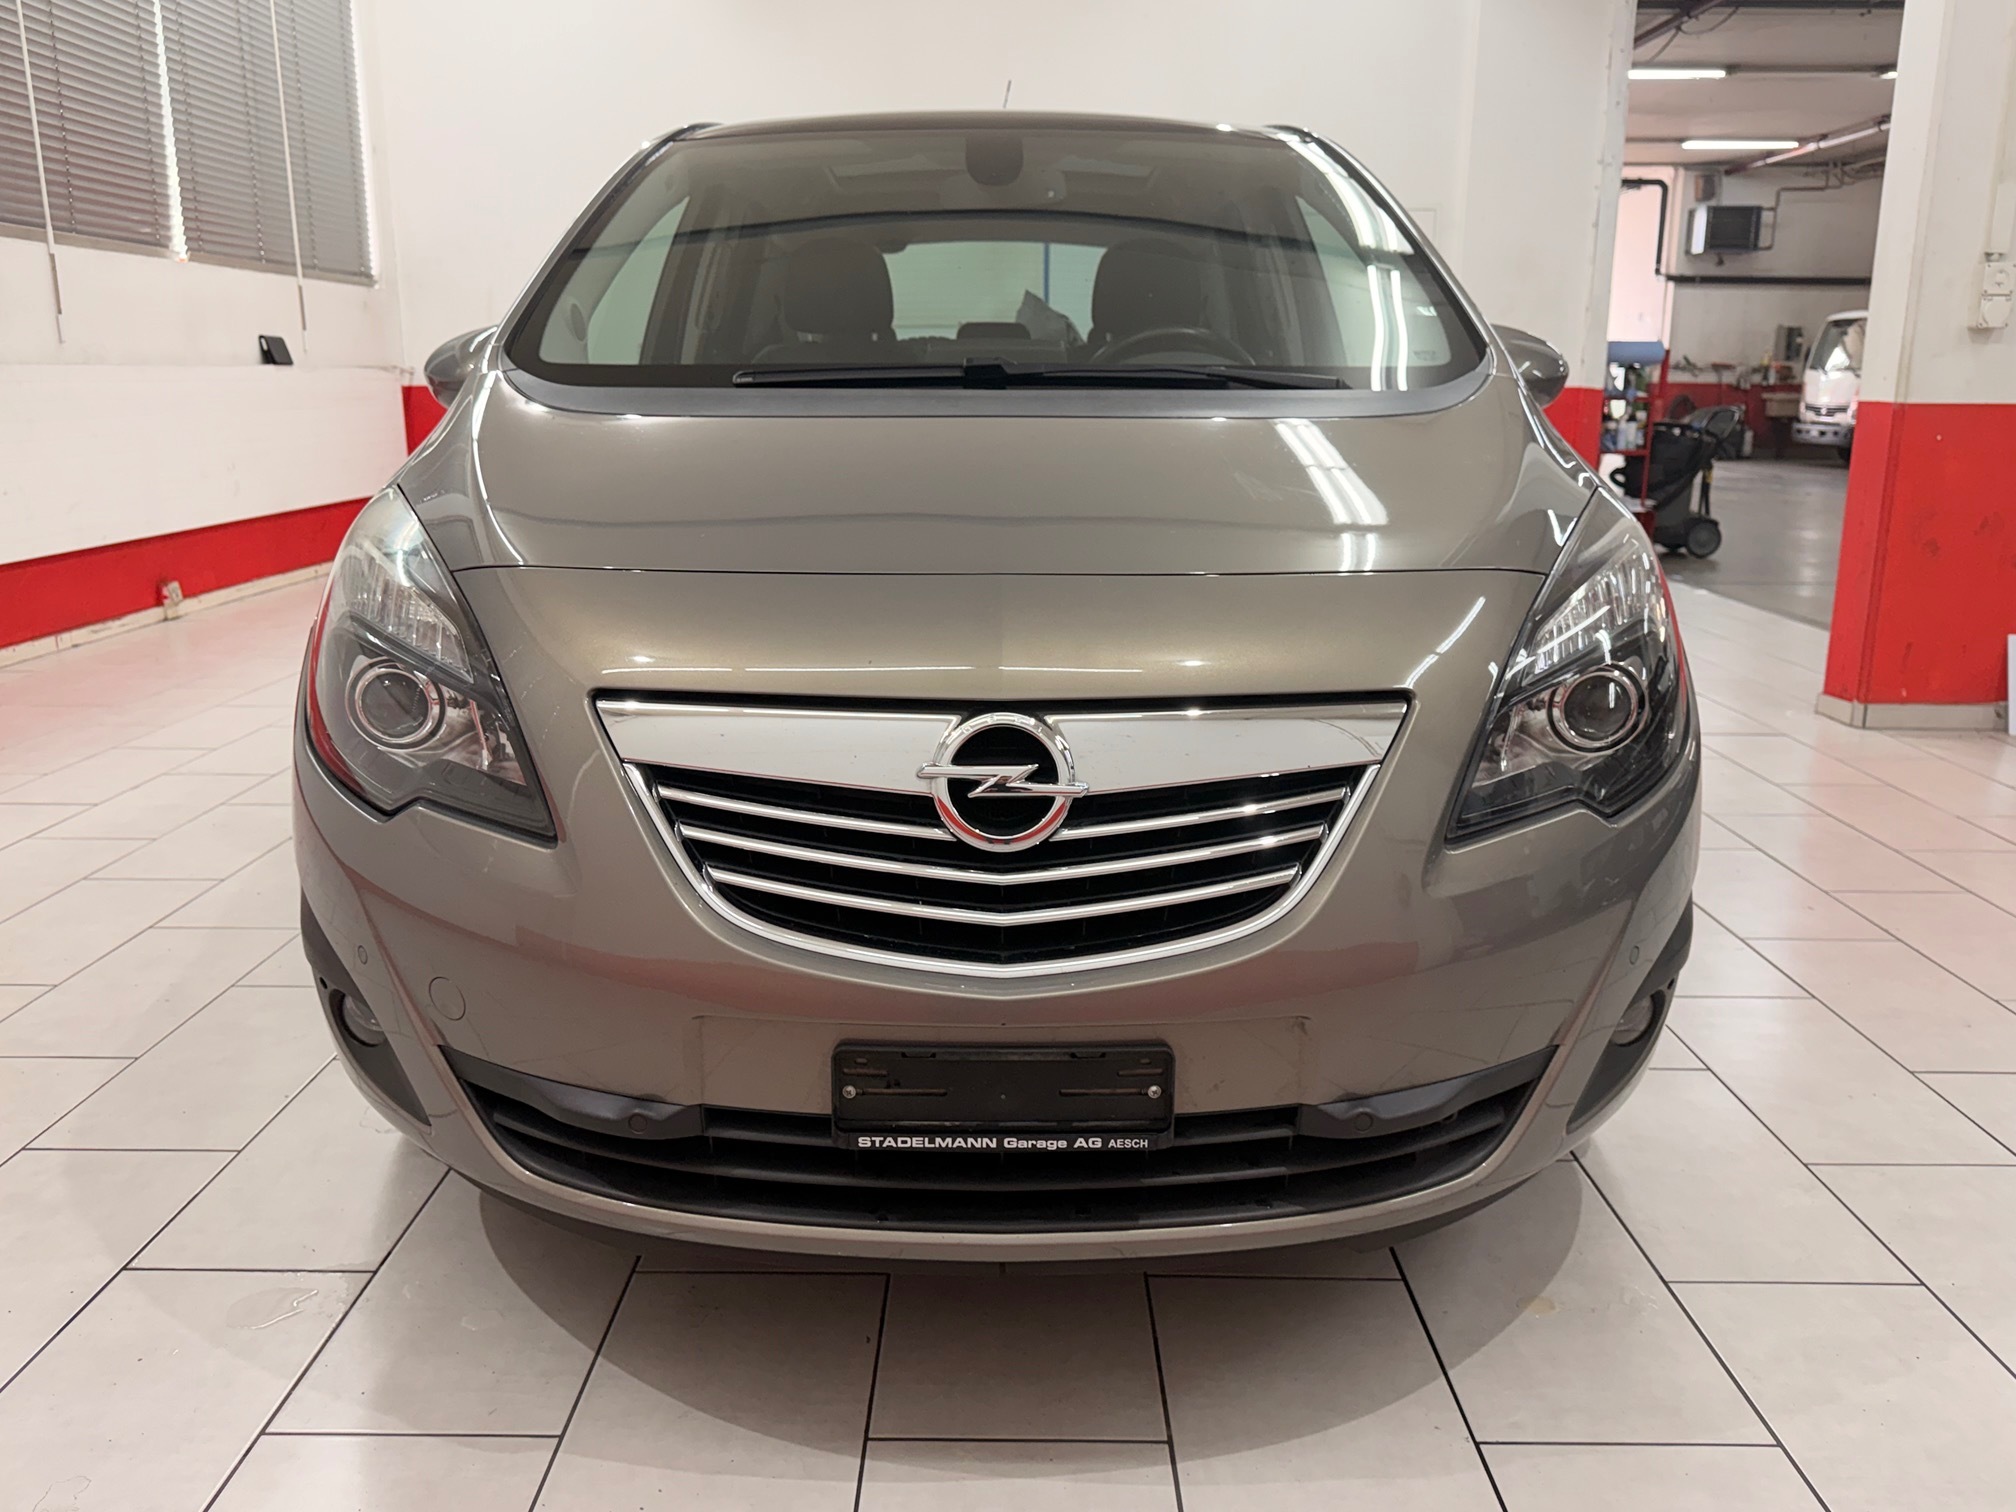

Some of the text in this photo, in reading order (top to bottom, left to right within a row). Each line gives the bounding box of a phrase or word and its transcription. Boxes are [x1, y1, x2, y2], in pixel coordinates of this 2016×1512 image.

[857, 1136, 1149, 1151] STADELMANN Garage AG AESCH
